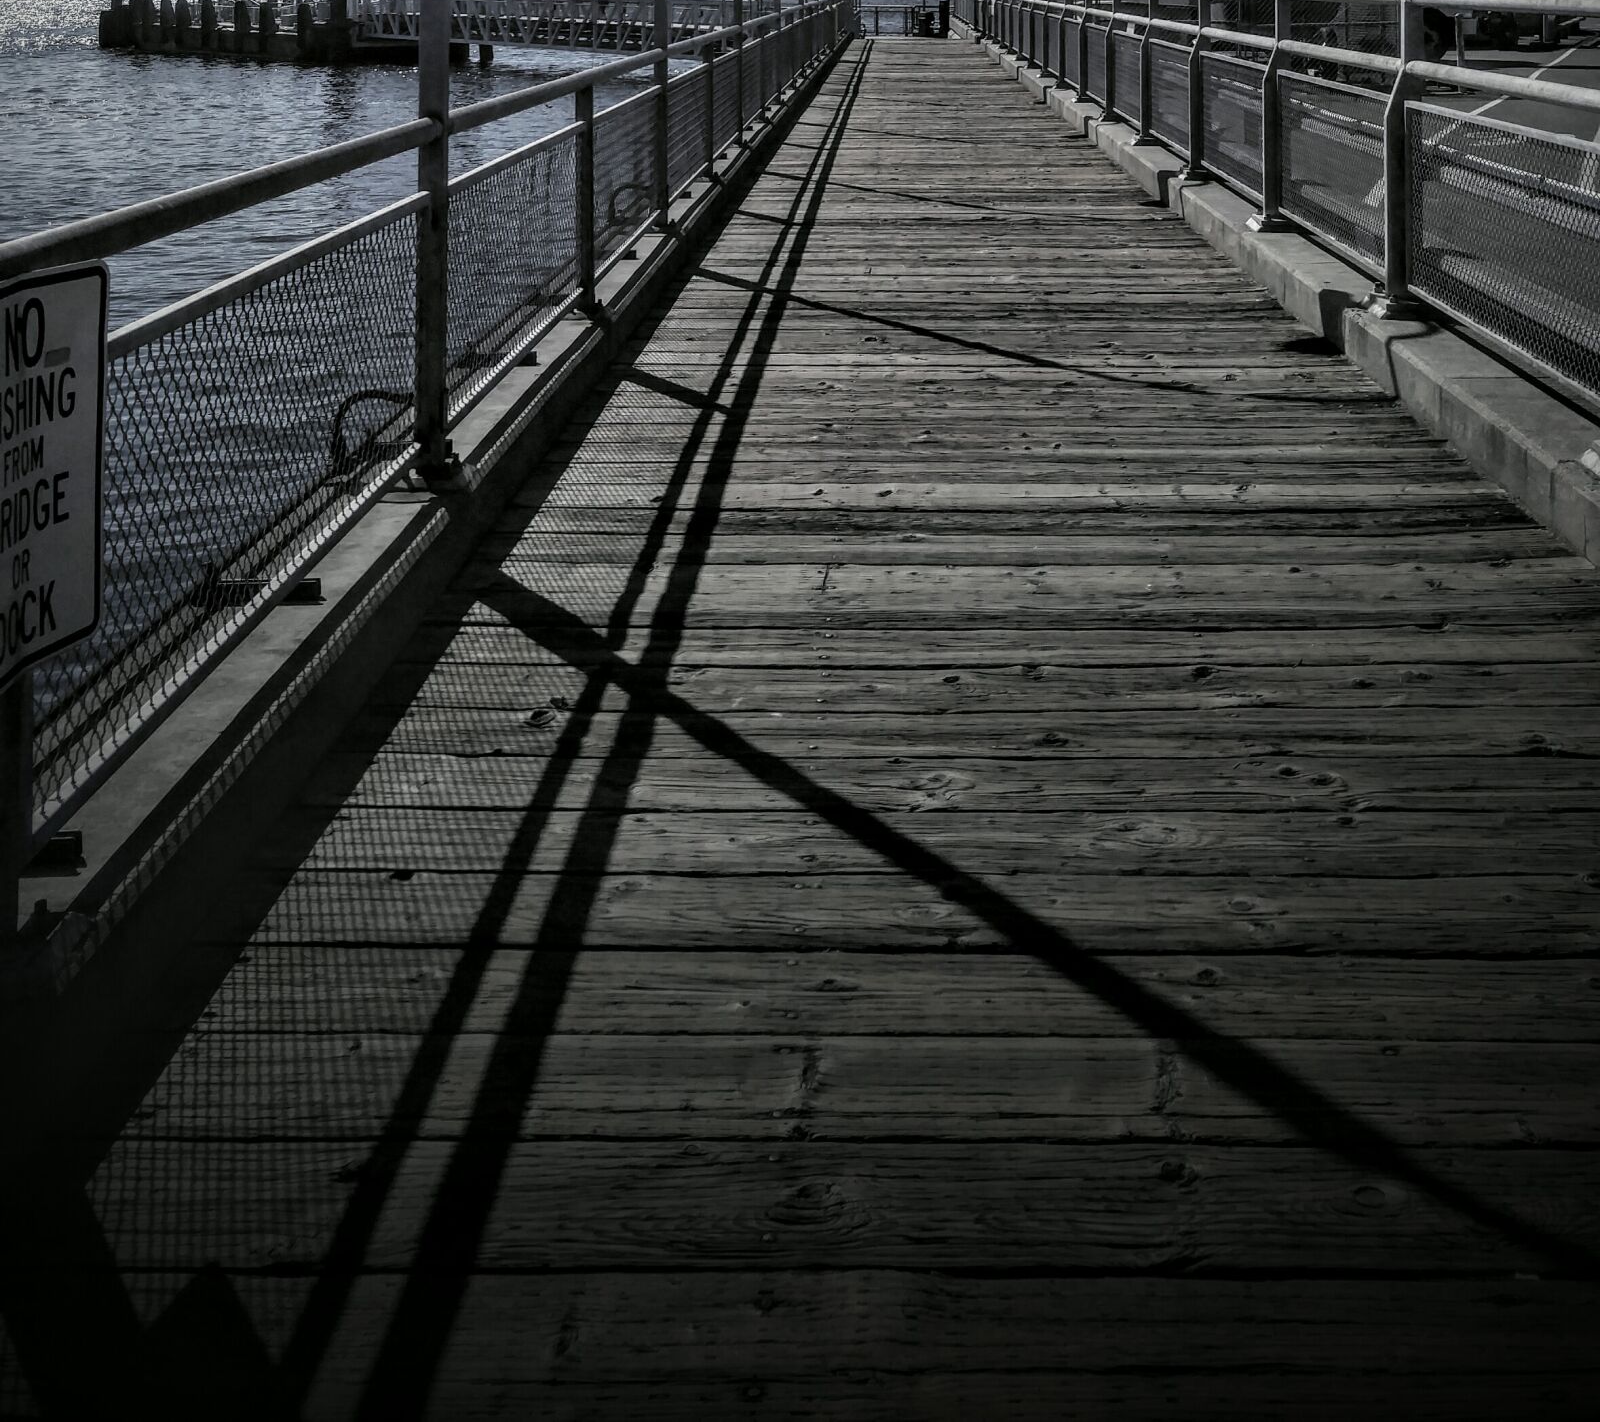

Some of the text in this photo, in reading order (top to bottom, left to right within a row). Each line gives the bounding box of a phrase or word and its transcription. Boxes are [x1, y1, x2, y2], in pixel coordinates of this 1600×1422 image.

[5, 297, 45, 377] NO
[0, 367, 76, 445] SHING
[4, 435, 44, 488] FROM
[1, 471, 69, 553] RIDGE
[12, 548, 30, 590] OR
